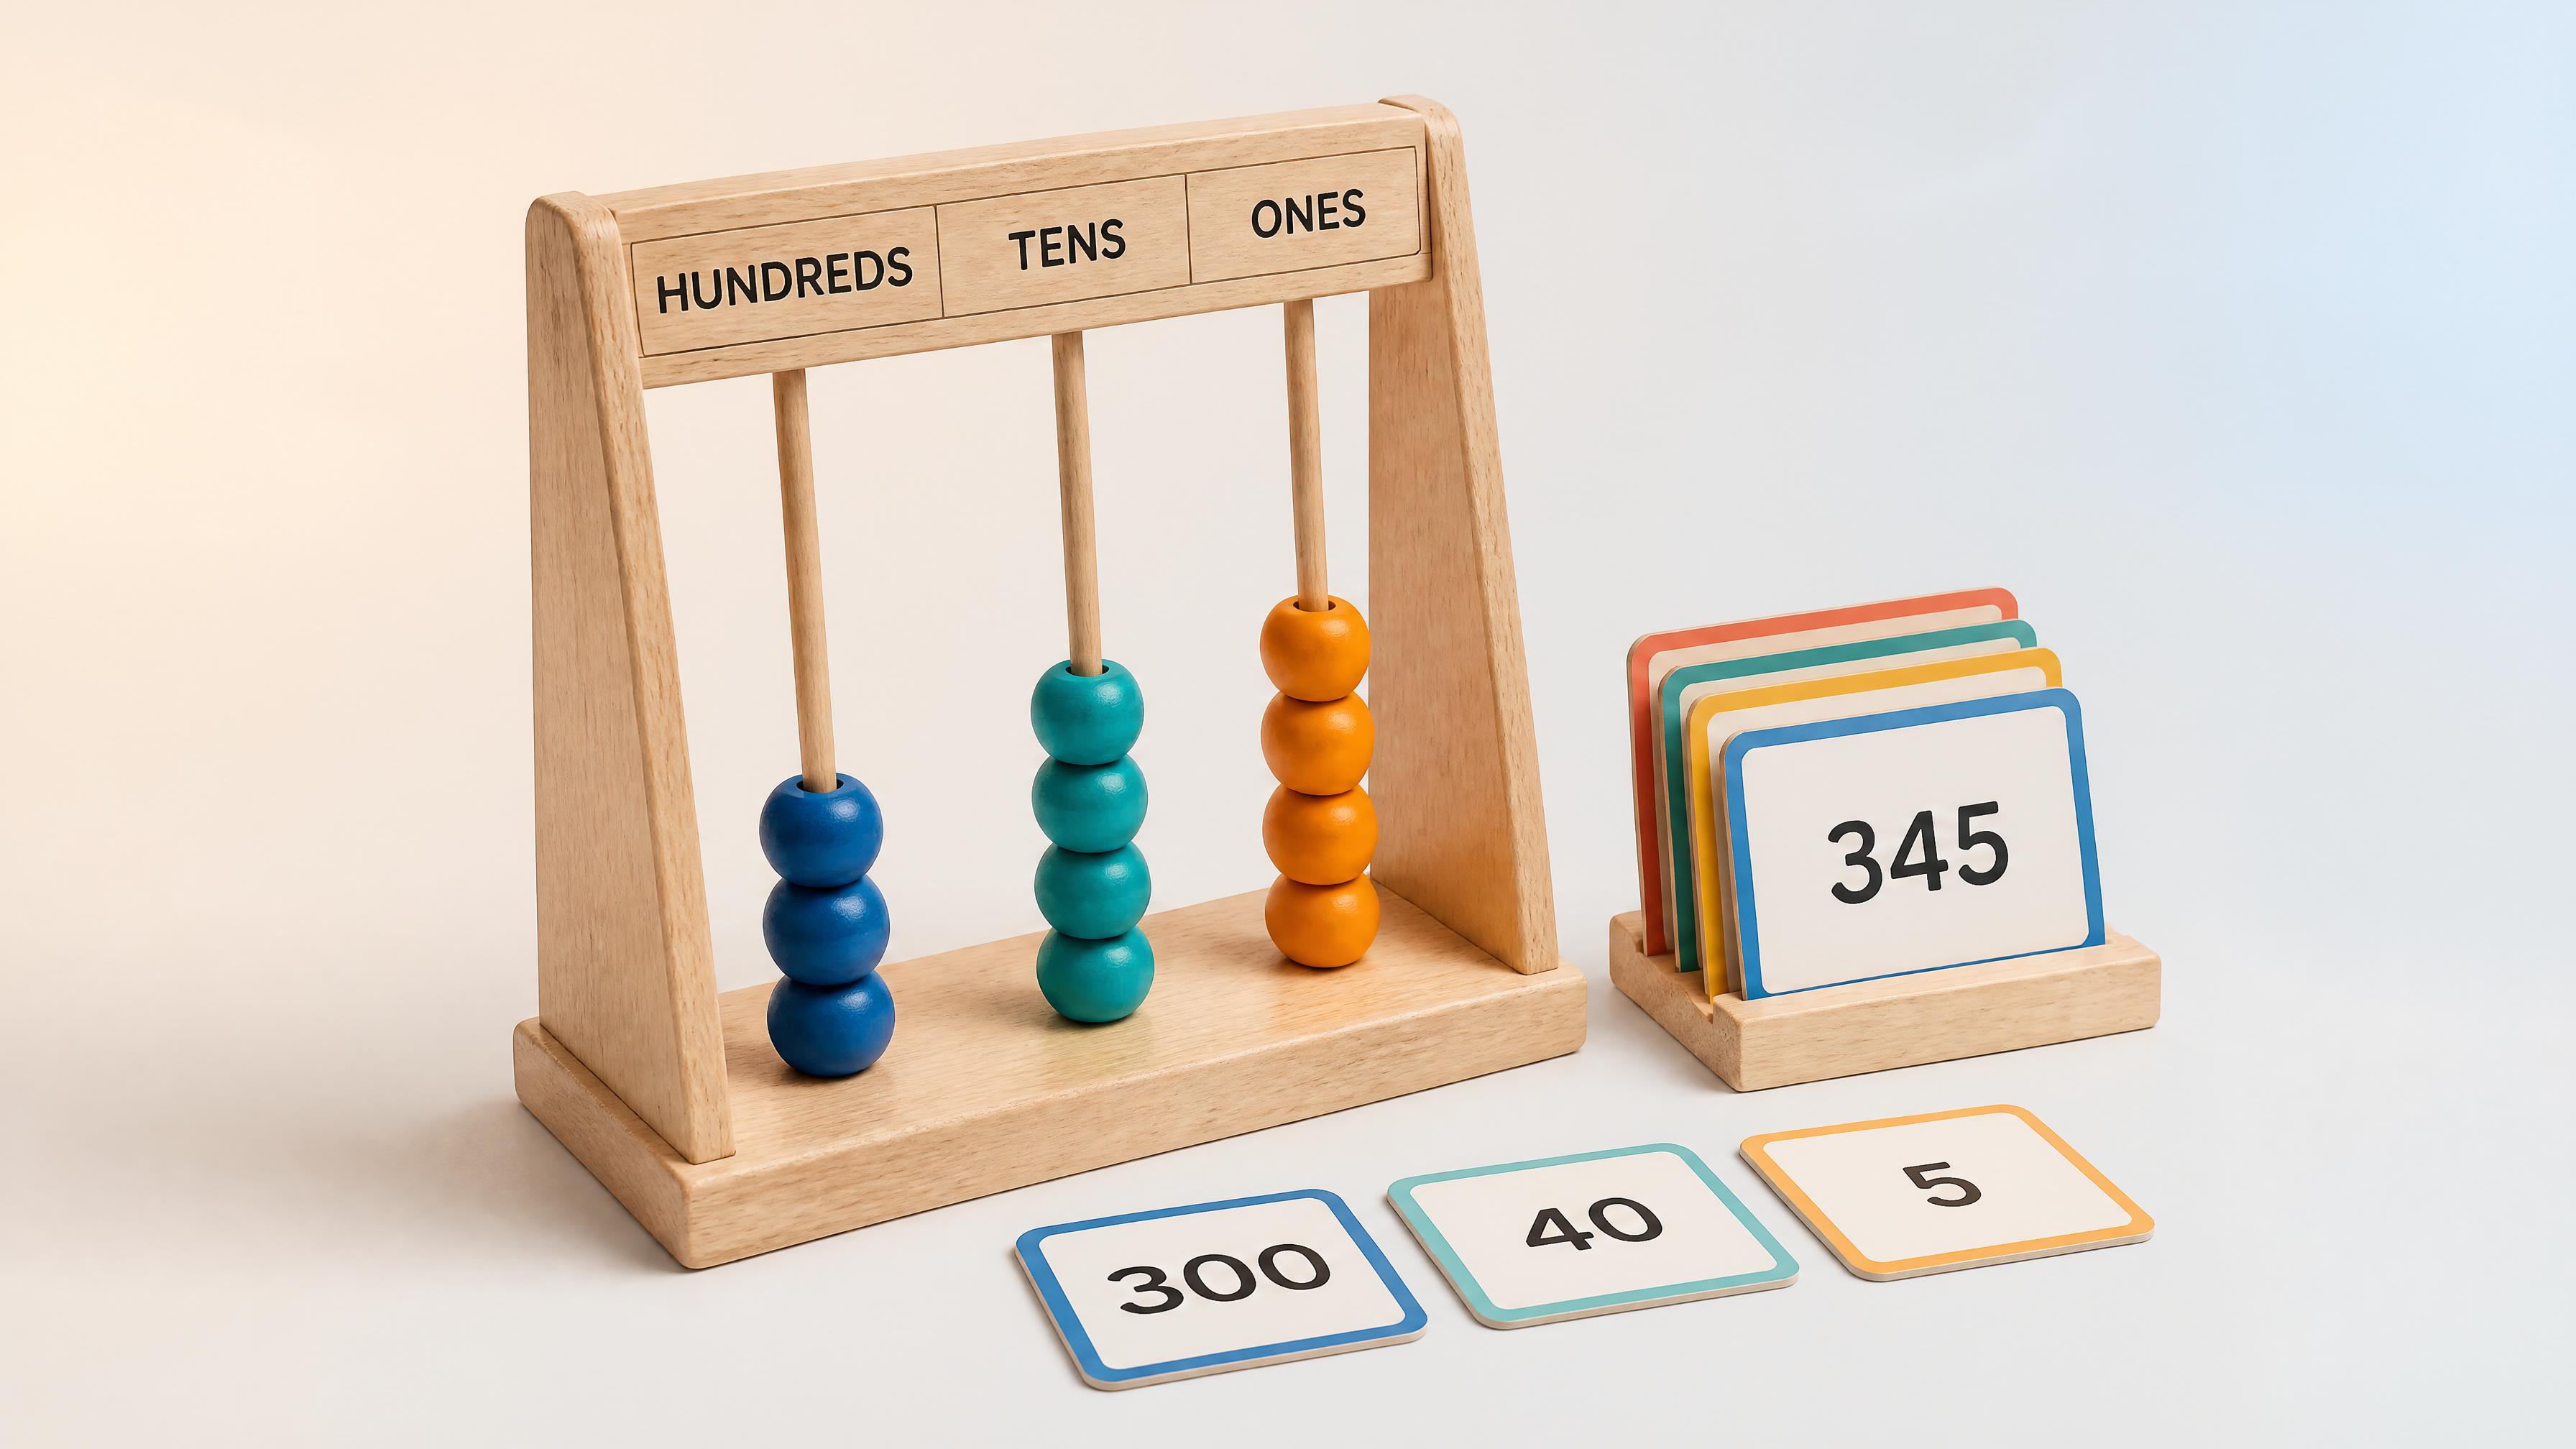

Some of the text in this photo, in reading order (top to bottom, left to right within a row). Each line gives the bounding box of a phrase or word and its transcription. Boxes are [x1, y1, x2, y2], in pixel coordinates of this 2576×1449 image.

[656, 188, 1366, 314] HUNDREDS TENS ONES
[1827, 801, 2009, 905] 345
[1902, 1162, 1982, 1208] 5
[1525, 1197, 1663, 1251] 40
[1107, 1243, 1330, 1315] 300
